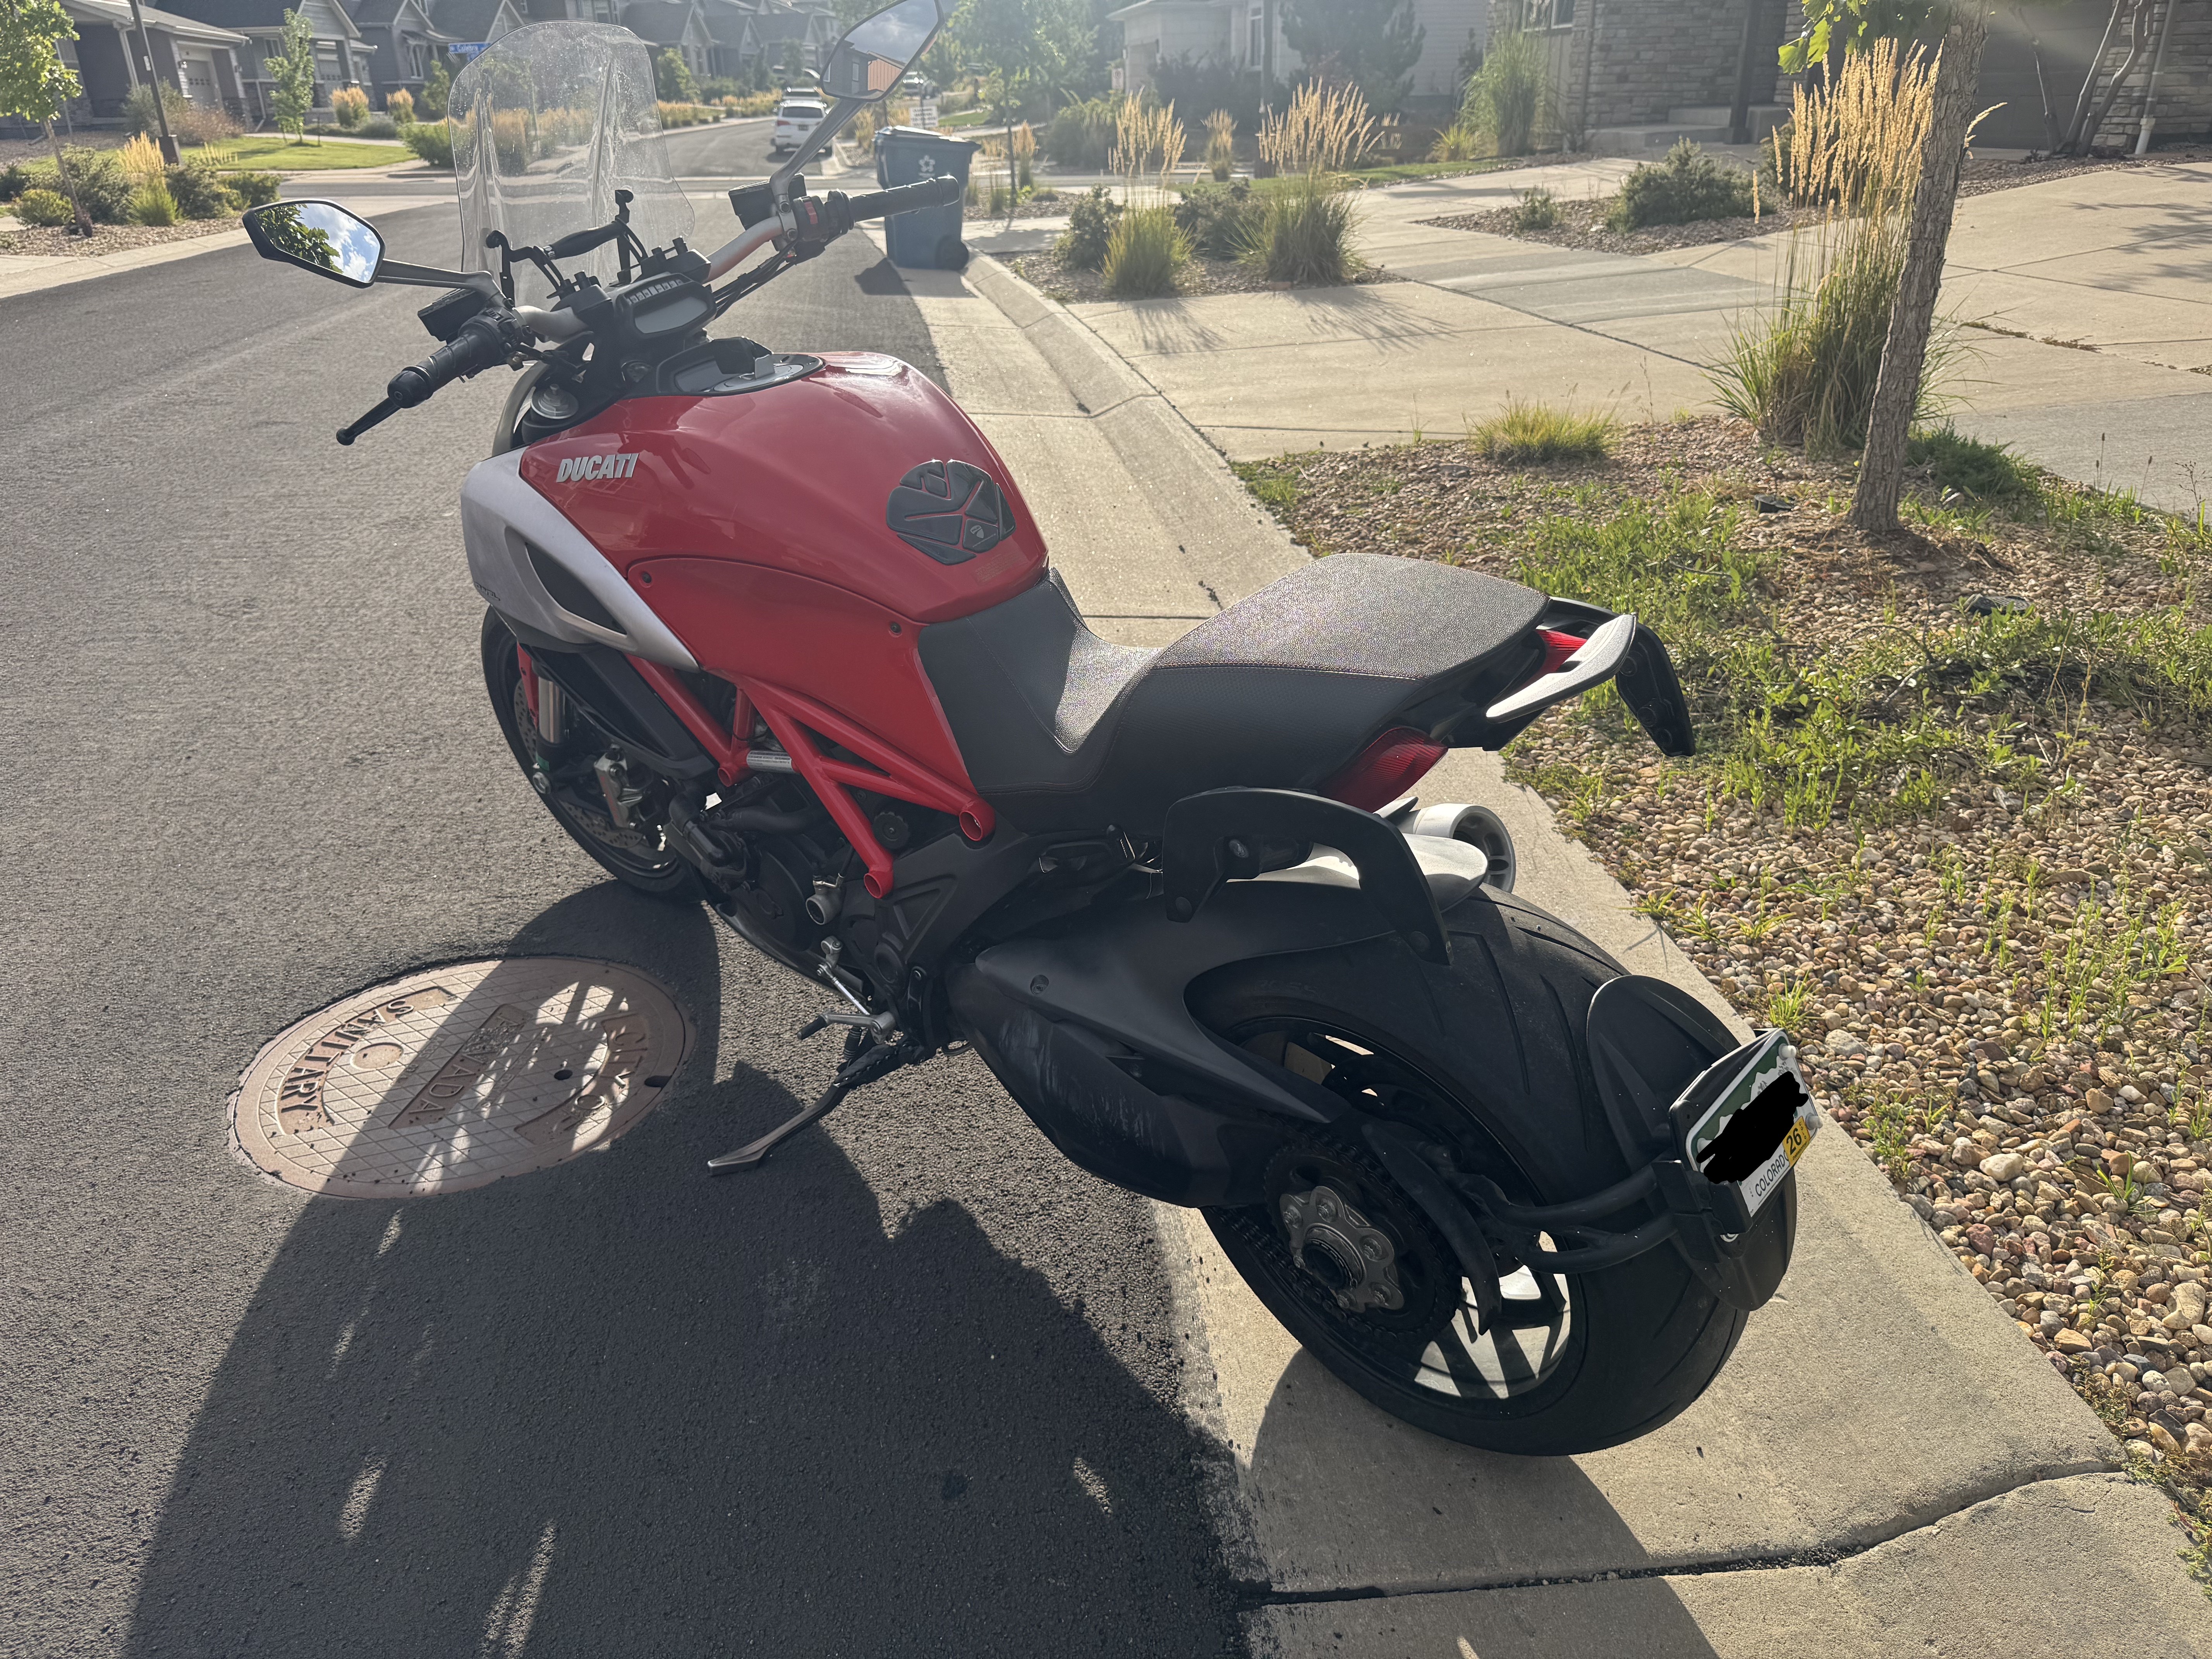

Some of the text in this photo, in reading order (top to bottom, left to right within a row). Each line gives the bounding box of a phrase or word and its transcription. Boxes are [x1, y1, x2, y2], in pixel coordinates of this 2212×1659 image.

[556, 453, 639, 483] DUCATI
[281, 999, 414, 1113] SANITARY
[409, 1016, 521, 1113] AVADA
[599, 1032, 648, 1089] CITY
[1786, 1128, 1802, 1155] 26
